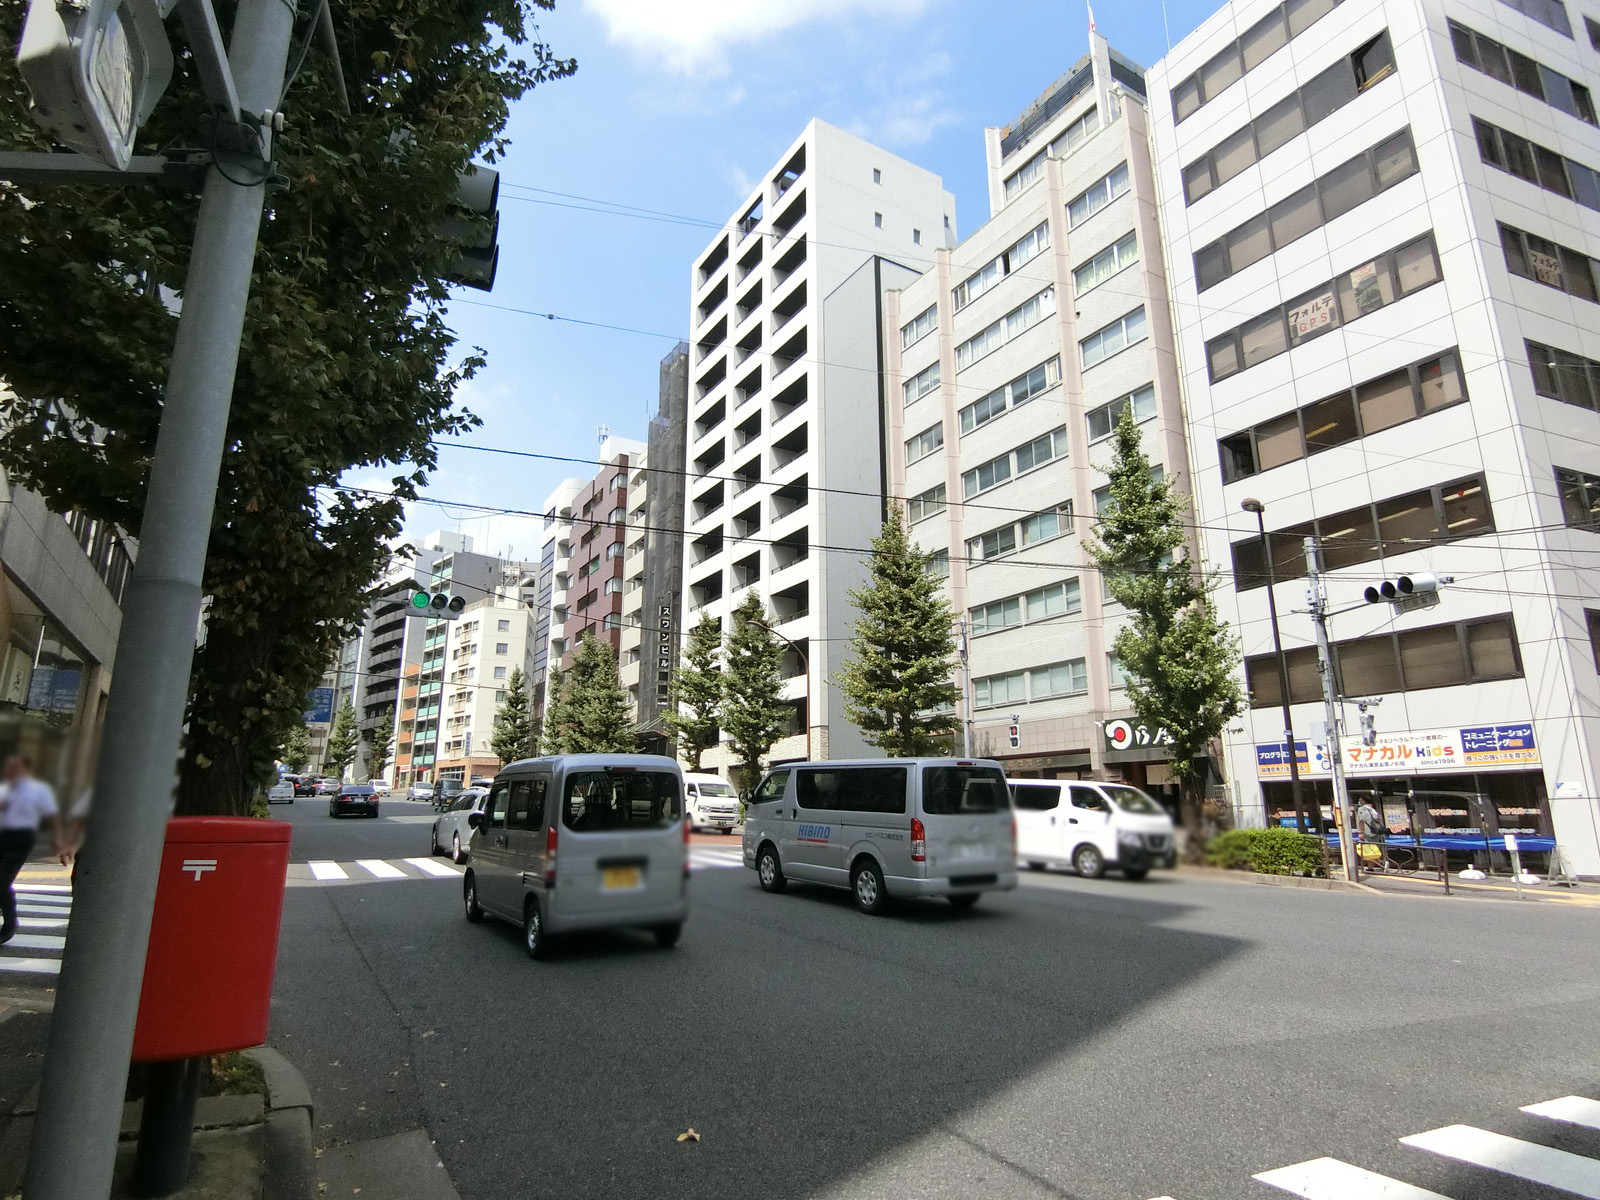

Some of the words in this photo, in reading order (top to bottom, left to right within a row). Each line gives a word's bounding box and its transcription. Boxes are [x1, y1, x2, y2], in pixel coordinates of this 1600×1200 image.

[1289, 295, 1332, 323] フォルテ
[1299, 312, 1328, 332] GPS
[661, 607, 670, 667] スワンビル
[1463, 729, 1531, 740] コミュニケーション
[1465, 739, 1509, 749] トレーニング
[798, 824, 831, 839] HIBINO
